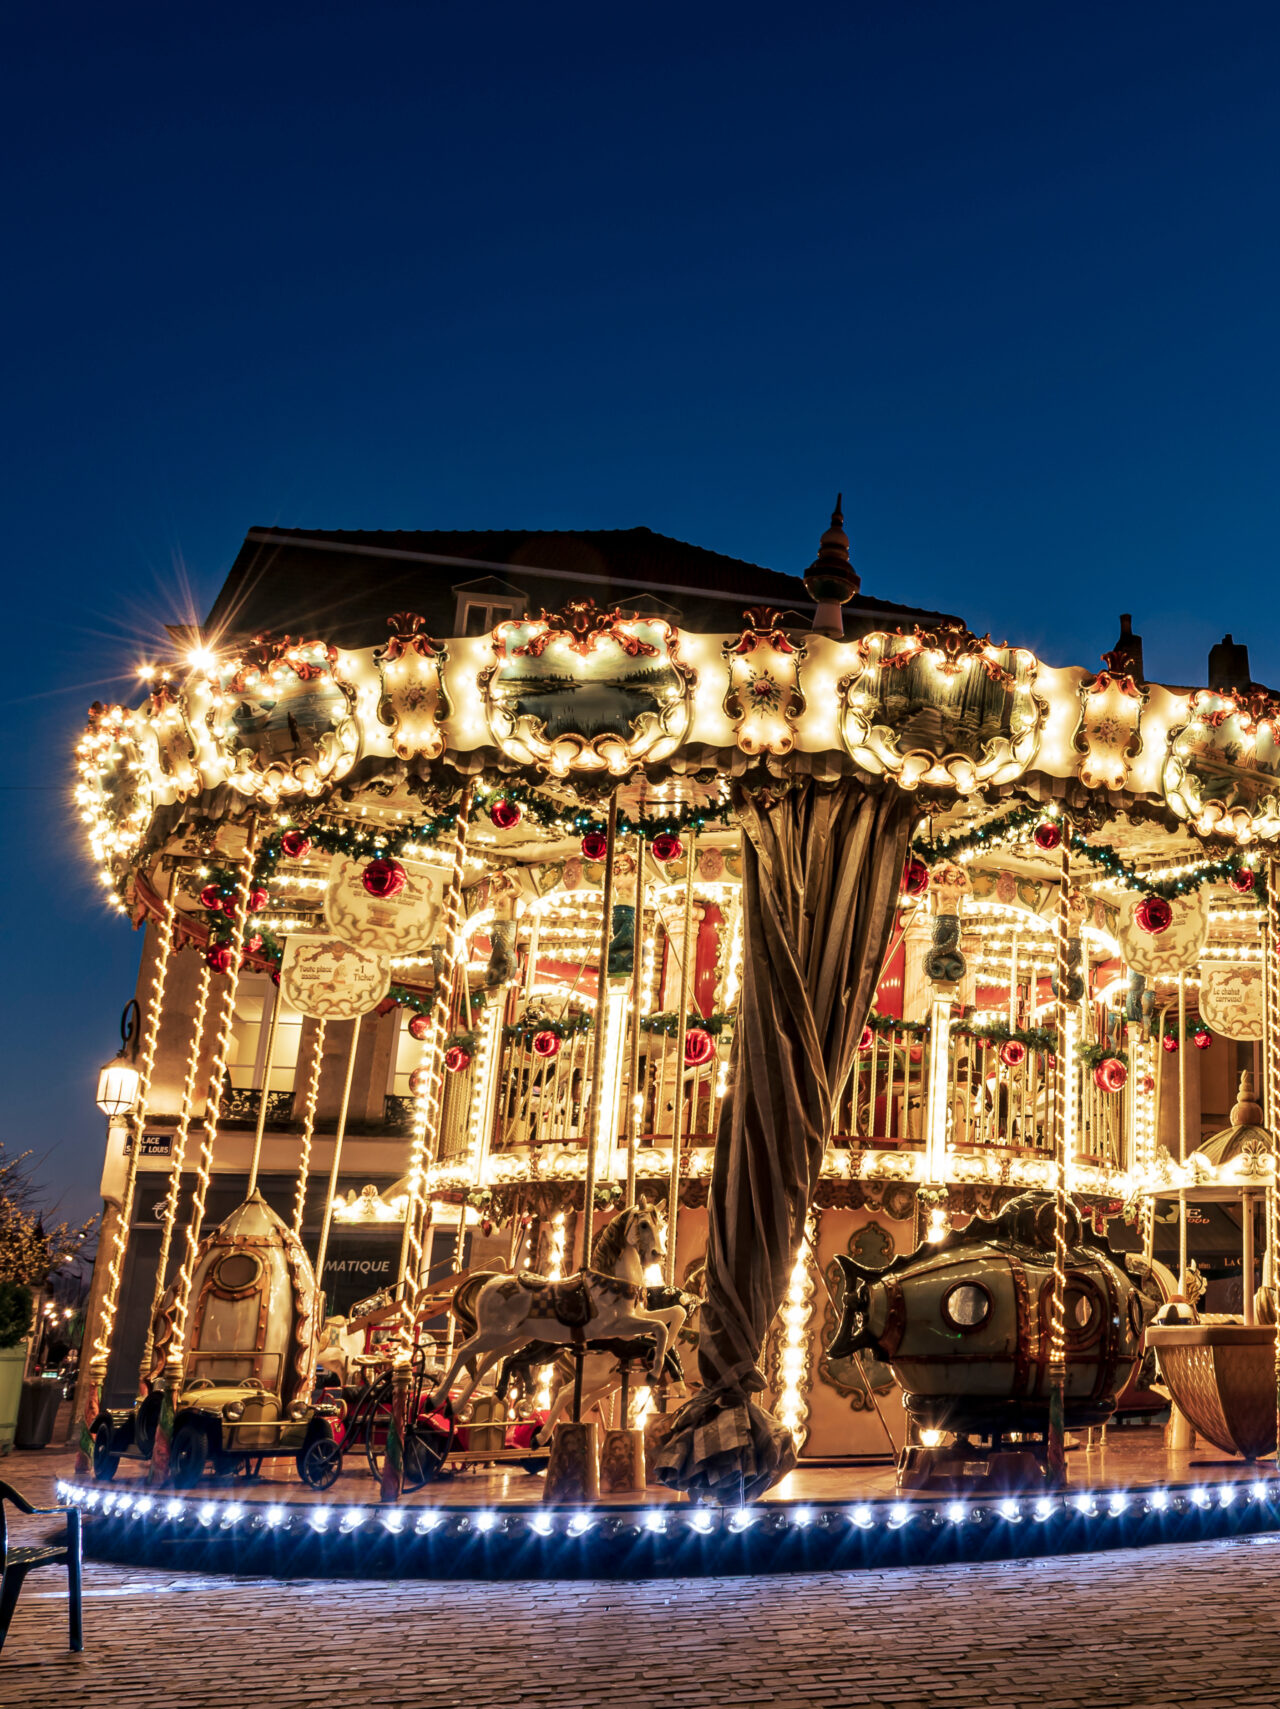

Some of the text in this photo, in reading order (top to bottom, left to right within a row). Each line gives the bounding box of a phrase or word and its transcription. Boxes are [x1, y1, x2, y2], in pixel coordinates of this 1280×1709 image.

[141, 1136, 160, 1145] LACE
[148, 1146, 169, 1154] LOUIS
[323, 1260, 390, 1274] MATIQUE
